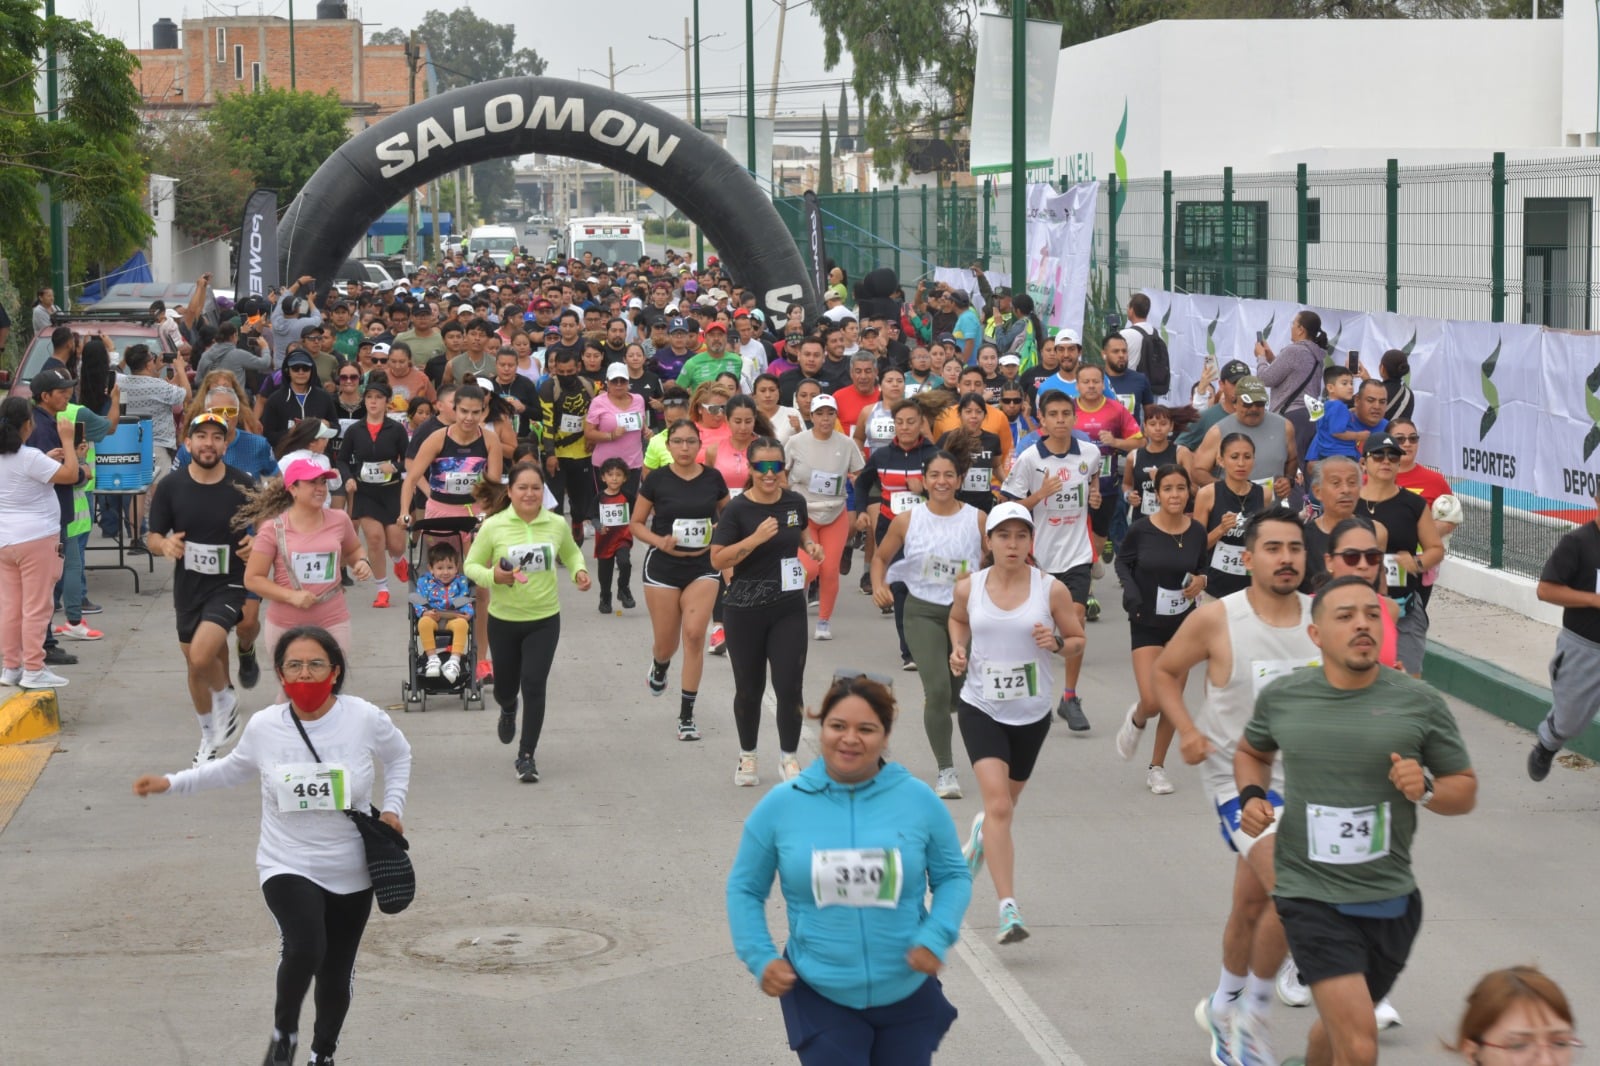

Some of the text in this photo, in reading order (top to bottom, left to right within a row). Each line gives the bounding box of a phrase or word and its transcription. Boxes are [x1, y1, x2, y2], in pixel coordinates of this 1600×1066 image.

[375, 93, 680, 179] SALOMON
[876, 425, 895, 433] 218
[1462, 446, 1516, 480] DEPORTES
[970, 474, 987, 482] 191
[824, 480, 831, 488] 9
[900, 497, 920, 505] 154
[1055, 493, 1078, 502] 294
[605, 509, 623, 518] 369
[684, 526, 706, 536] 134
[194, 554, 217, 566] 170
[305, 561, 321, 572] 14
[932, 561, 956, 576] 251
[994, 676, 1025, 689] 172
[293, 782, 330, 798] 464
[1340, 820, 1370, 839] 24
[835, 866, 884, 885] 320
